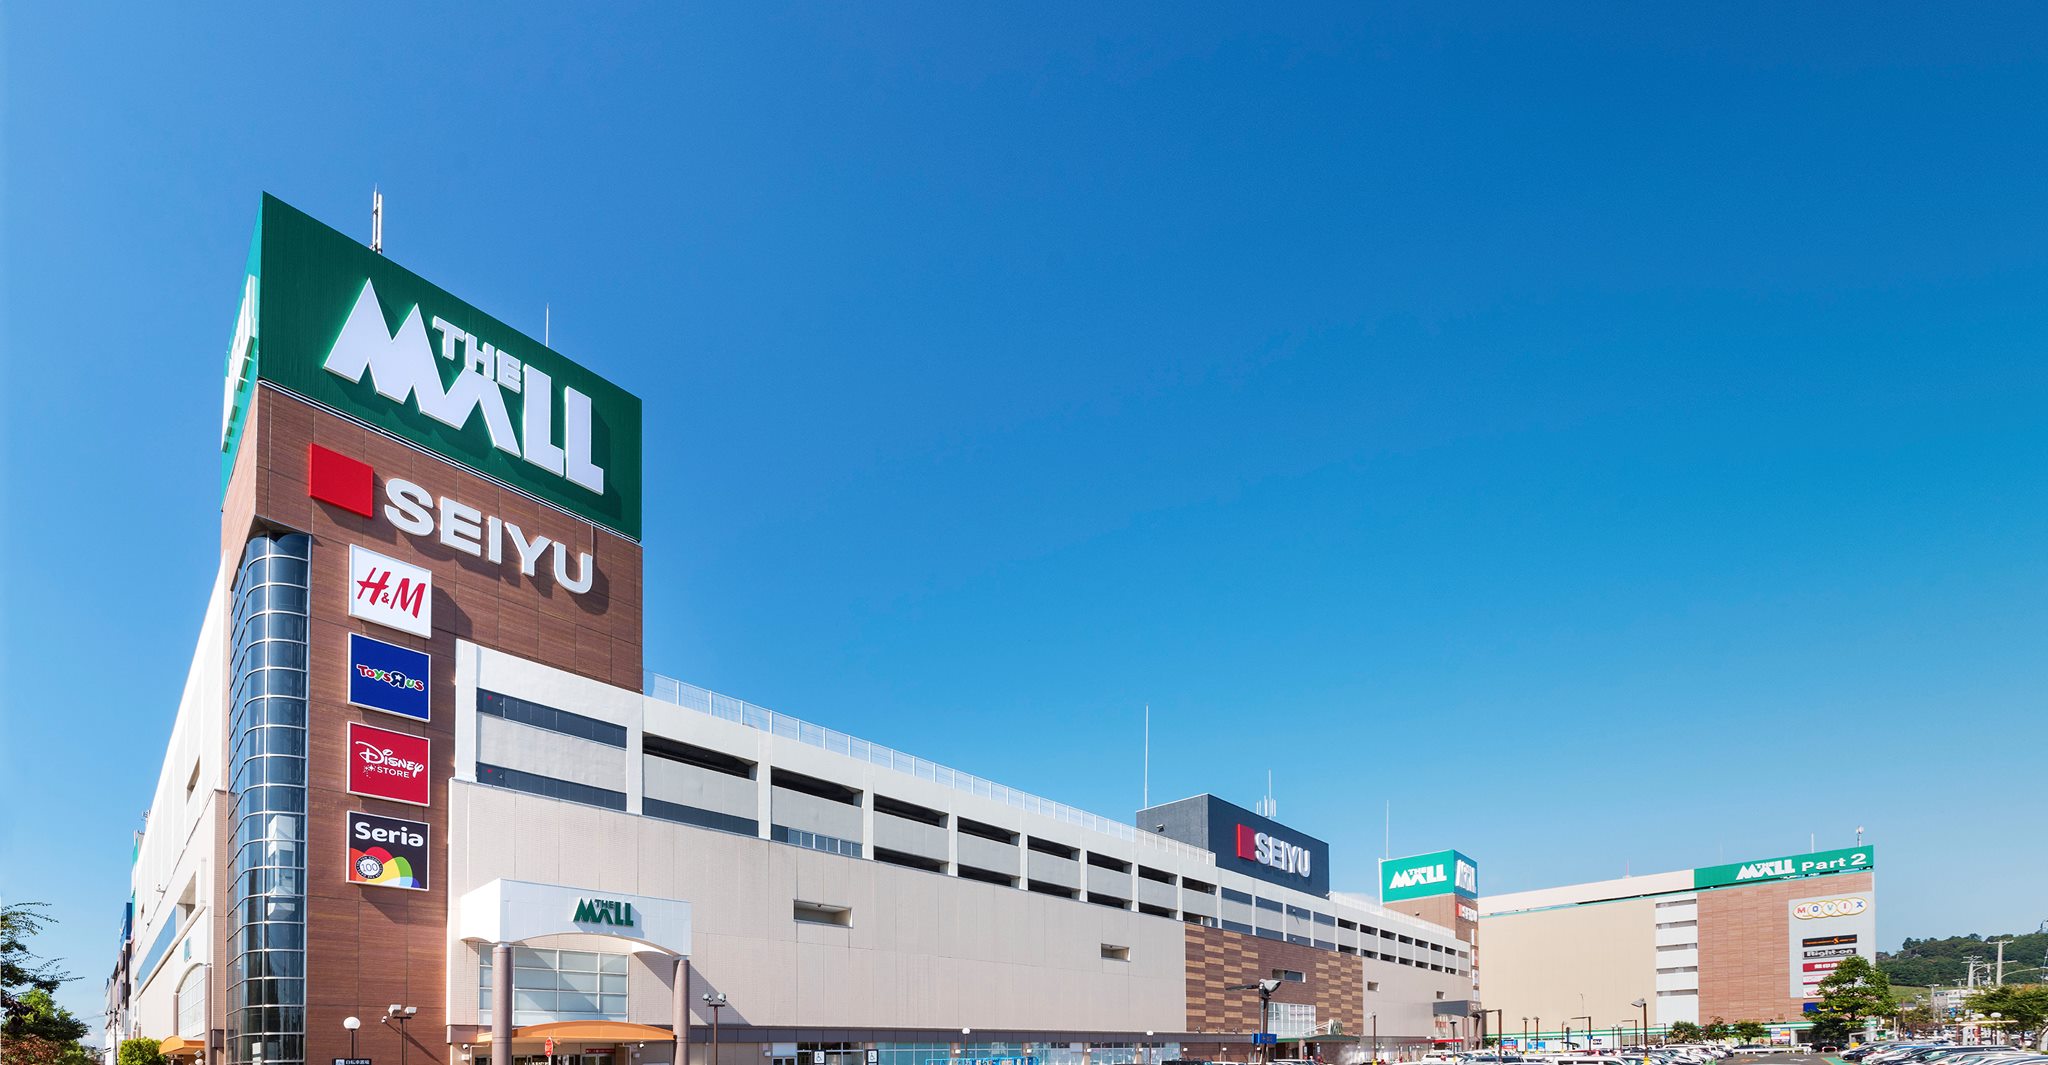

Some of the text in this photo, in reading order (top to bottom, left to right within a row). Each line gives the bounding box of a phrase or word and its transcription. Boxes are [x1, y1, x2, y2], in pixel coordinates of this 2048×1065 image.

[432, 315, 522, 394] THE
[323, 277, 604, 496] MALL
[383, 477, 594, 595] SEIYU
[356, 566, 426, 619] H&M
[377, 766, 410, 779] STORE
[354, 821, 424, 848] Seria
[361, 862, 379, 872] 100
[1254, 832, 1311, 878] SEIYU
[1735, 853, 1867, 880] MALL Part 2
[1389, 863, 1448, 890] MALL
[572, 896, 634, 927] MALL
[594, 899, 615, 909] THE
[1797, 901, 1864, 914] MOVIX
